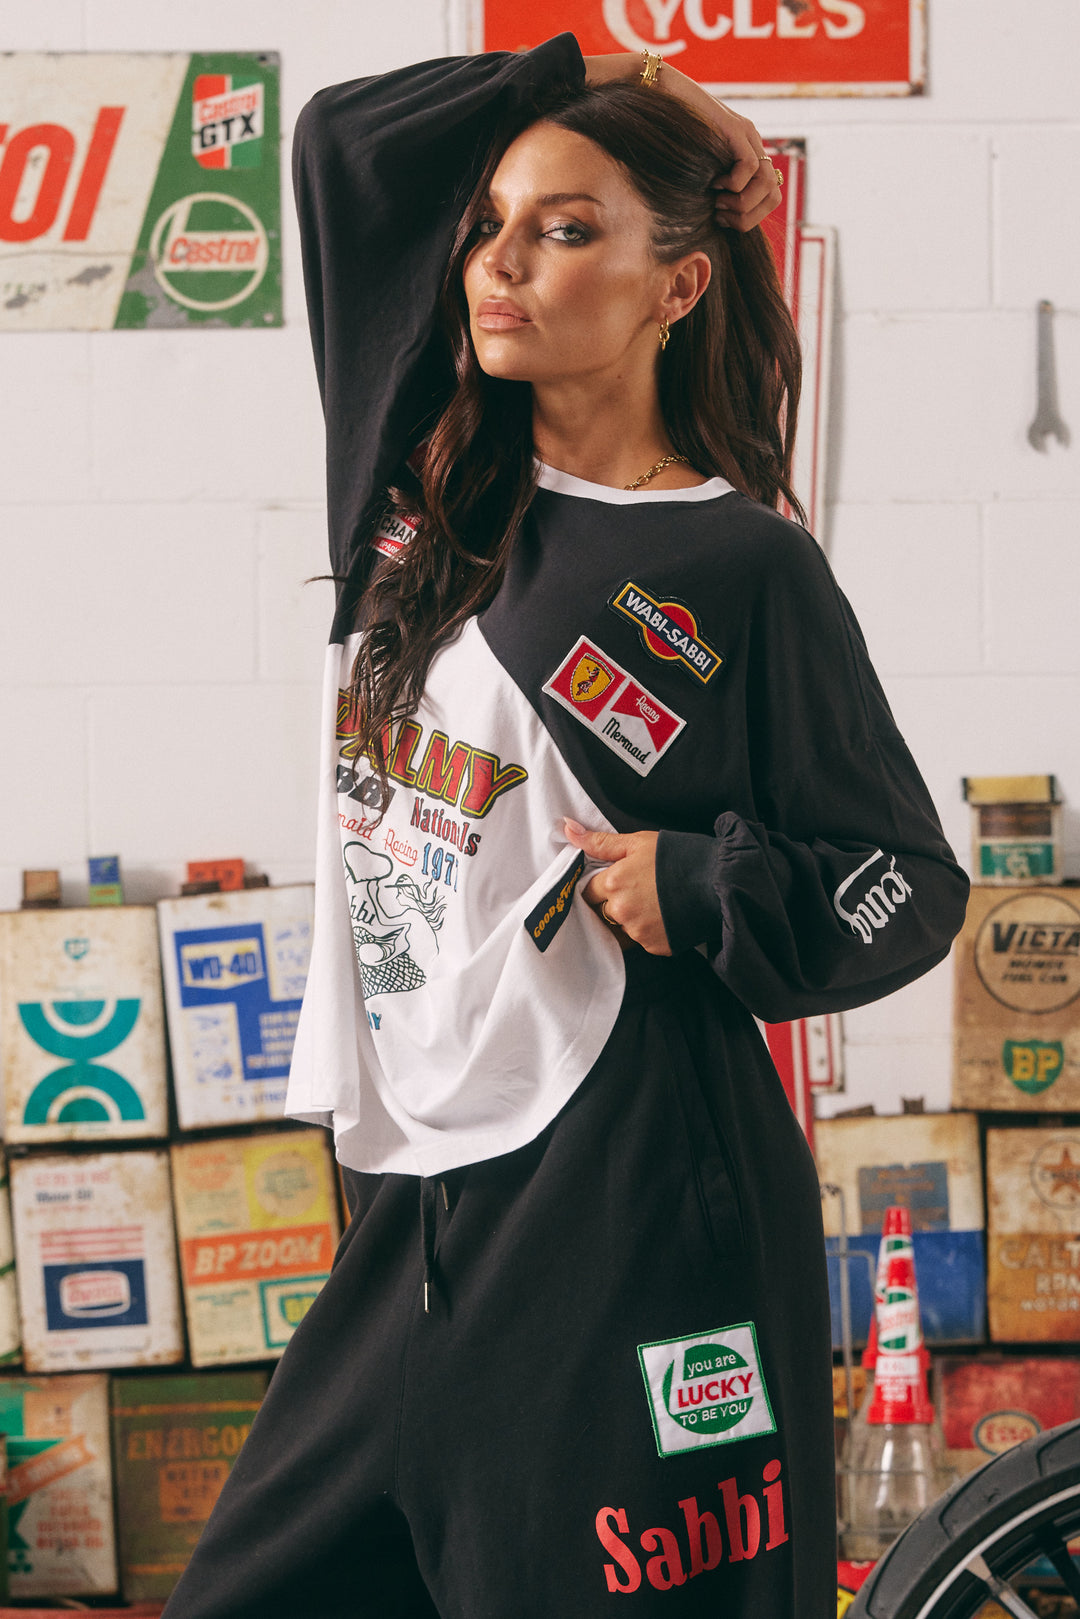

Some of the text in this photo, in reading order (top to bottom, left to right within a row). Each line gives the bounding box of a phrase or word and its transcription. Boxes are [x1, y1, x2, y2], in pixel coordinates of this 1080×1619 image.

[200, 111, 256, 149] GTX
[0, 106, 127, 243] ol
[169, 236, 260, 265] Castrol
[625, 591, 712, 672] WABI-SABBI
[635, 694, 660, 724] Racing
[601, 717, 652, 765] Mermaid
[410, 796, 482, 857] Nationls
[384, 828, 421, 867] Racing
[421, 842, 459, 893] 197
[533, 904, 557, 939] GOOD
[187, 952, 257, 980] WD-40
[1011, 1045, 1060, 1081] BP
[193, 1232, 324, 1275] BP ZOOM
[687, 1353, 737, 1378] you are
[677, 1371, 754, 1409] LUCKY
[679, 1401, 748, 1427] TO BE YOU
[595, 1458, 789, 1594] Sabbi
